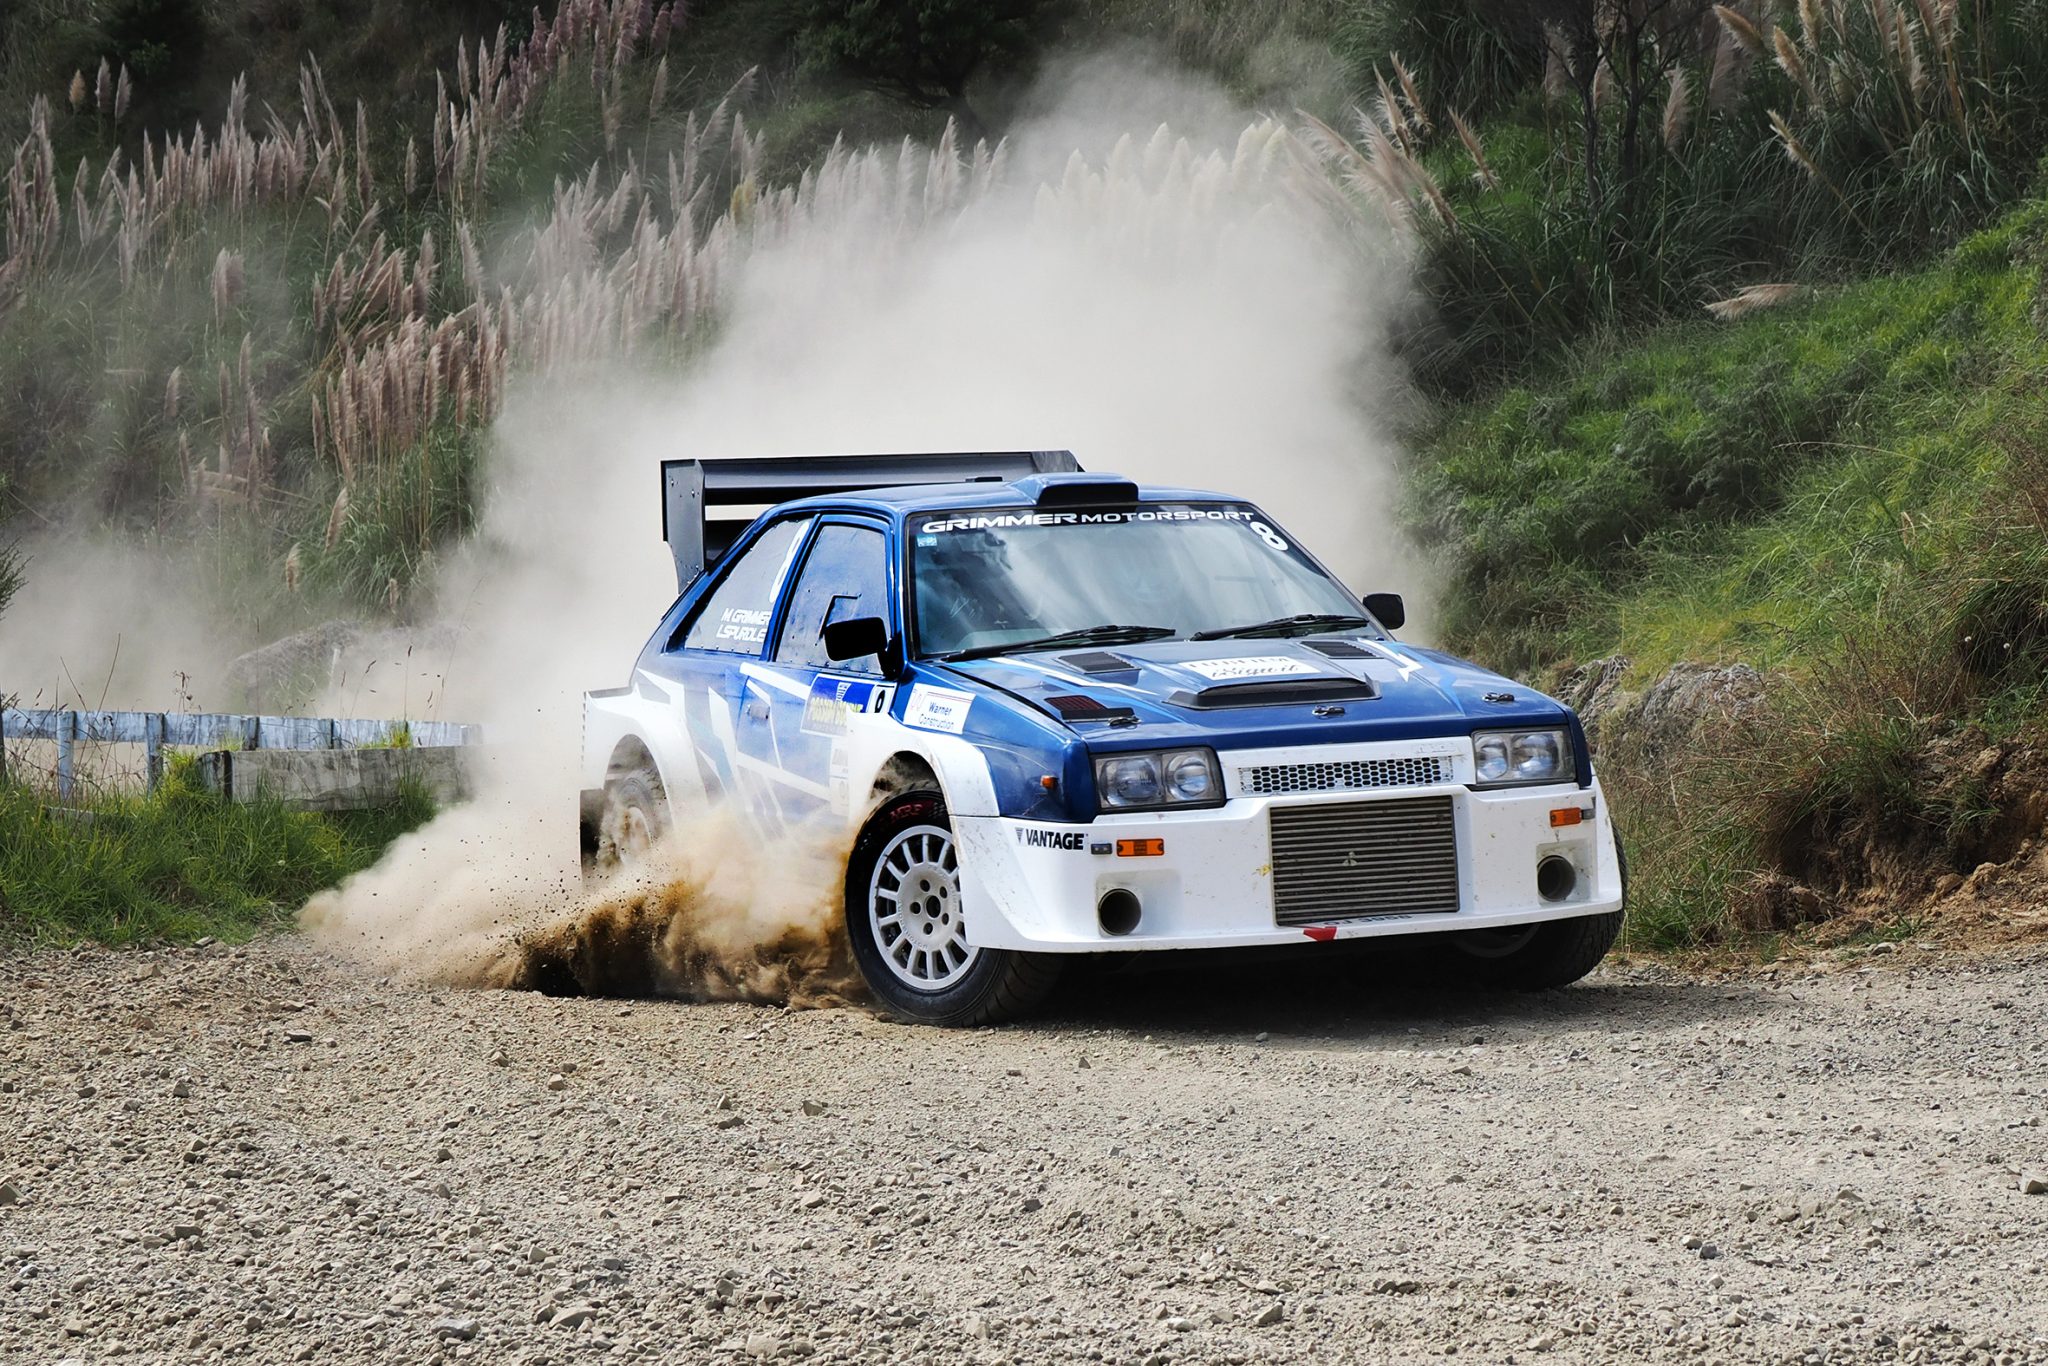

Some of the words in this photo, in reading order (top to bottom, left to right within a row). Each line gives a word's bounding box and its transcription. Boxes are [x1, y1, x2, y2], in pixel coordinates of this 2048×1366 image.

[922, 512, 1078, 534] GRIMMER
[1081, 510, 1255, 524] MOTORSPORT
[1249, 521, 1289, 552] 8
[929, 701, 952, 716] Warner
[1025, 828, 1085, 850] VANTAGE
